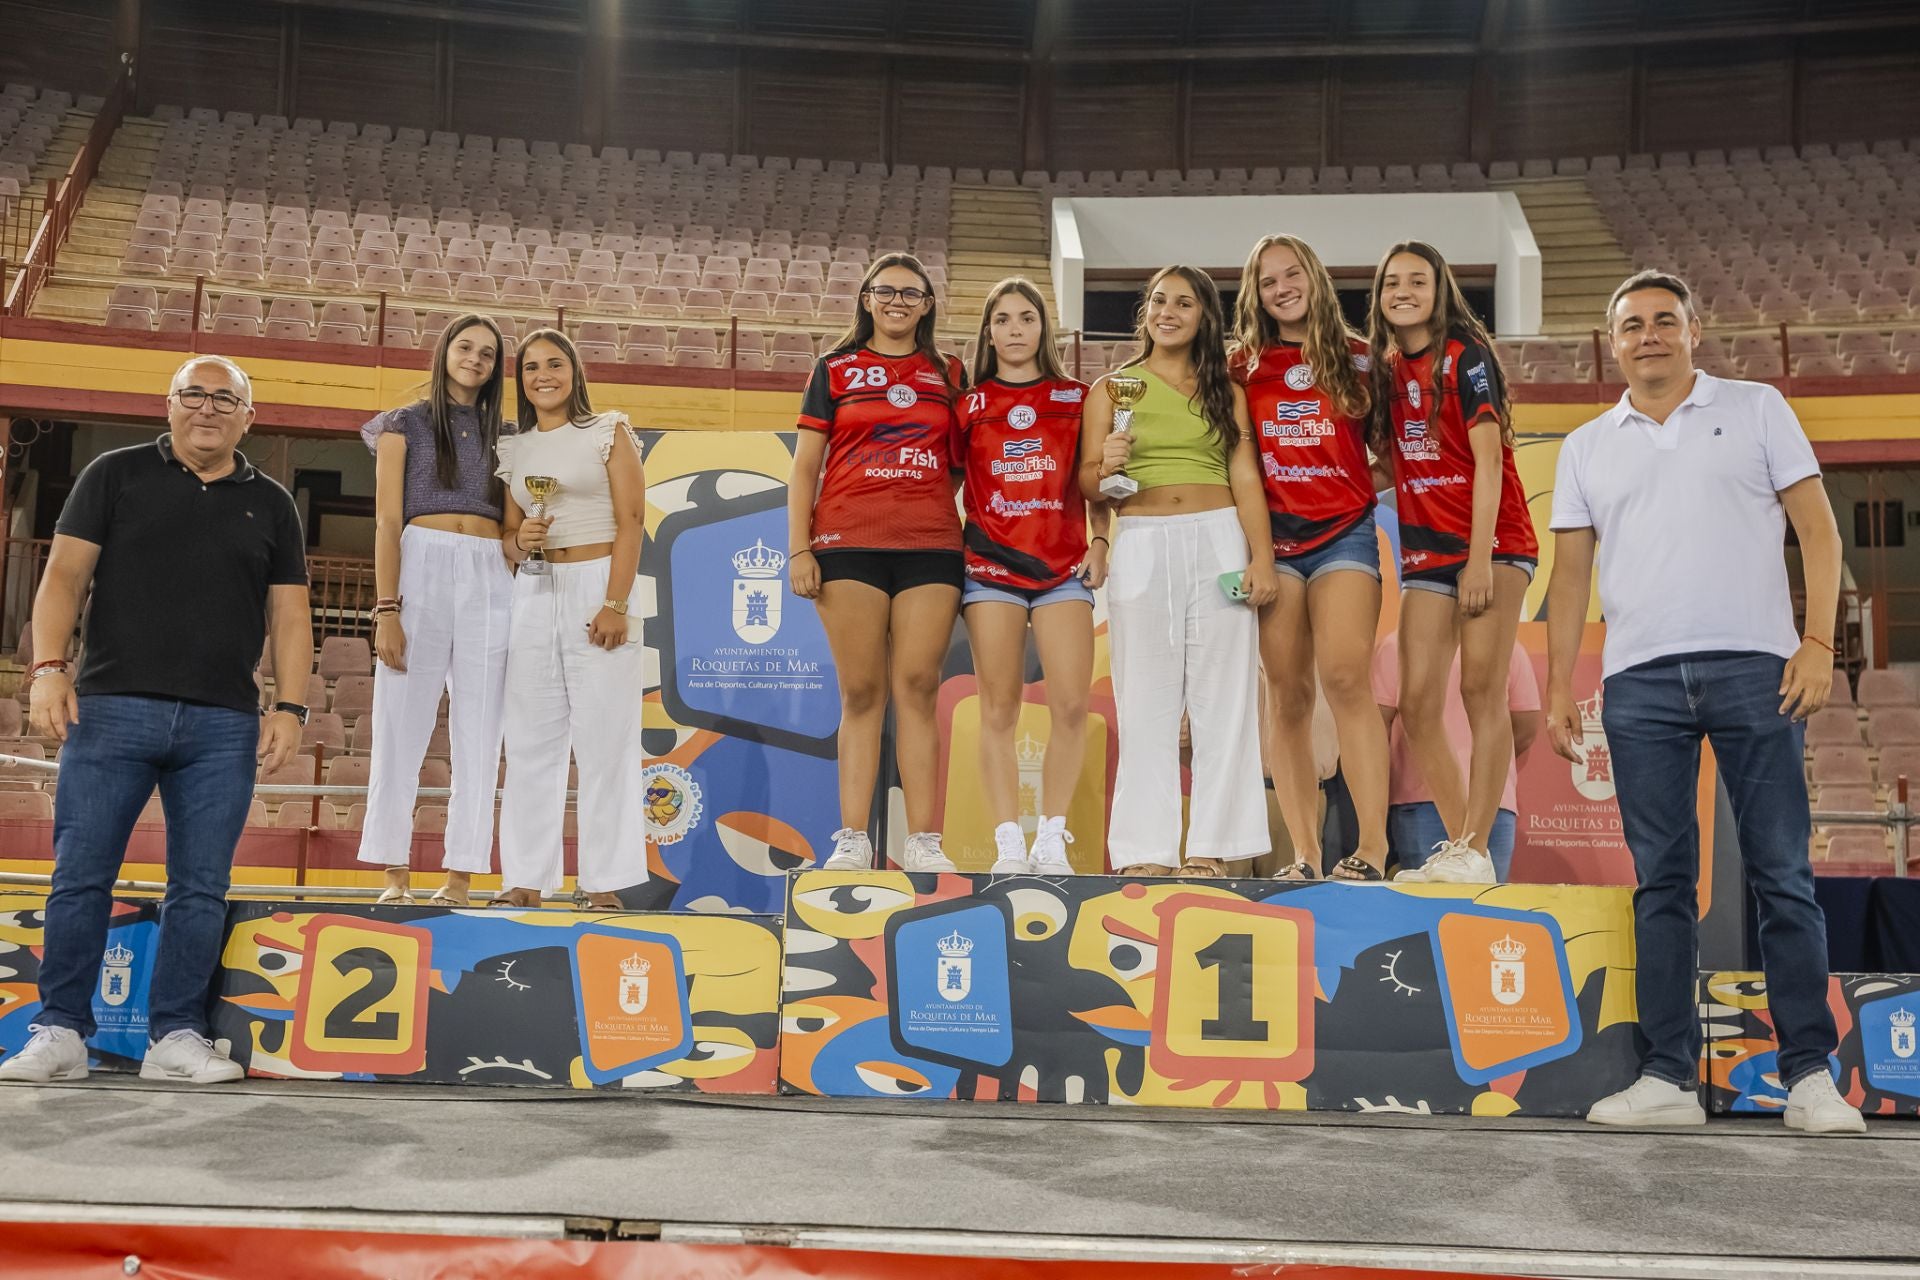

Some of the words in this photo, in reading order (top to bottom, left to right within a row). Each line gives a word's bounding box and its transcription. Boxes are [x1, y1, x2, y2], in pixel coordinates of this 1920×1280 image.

[845, 366, 887, 390] 28
[966, 392, 986, 414] 21
[1263, 419, 1334, 436] EuroFish
[1280, 437, 1320, 445] ROQUETAS
[847, 447, 938, 469] EuroFish
[992, 456, 1056, 475] EuroFish
[865, 468, 922, 479] ROQUETAS
[1006, 471, 1043, 481] ROQUETAS
[714, 648, 785, 656] AYUNTAMIENTO
[787, 648, 799, 656] DE
[692, 658, 760, 673] ROQUETAS
[765, 661, 781, 672] DE
[787, 659, 819, 673] MAR
[688, 680, 704, 688] Área
[715, 681, 746, 690] Deportes,
[779, 682, 805, 690] Tiempo
[805, 682, 823, 690] Libre
[642, 764, 690, 781] OQUETAS
[1553, 804, 1617, 813] AYUNTAMIEN
[1530, 815, 1603, 831] ROQUETAS
[1527, 838, 1543, 847] Área
[1545, 839, 1555, 847] de
[1556, 839, 1590, 848] Deportes,
[1592, 839, 1618, 848] Cultura
[324, 947, 399, 1040] 2
[1195, 934, 1268, 1041] 1
[910, 1010, 956, 1021] ROQUETAS
[975, 1012, 997, 1021] MAR
[1465, 1013, 1512, 1024] ROQUETAS
[1515, 1016, 1525, 1024] DE
[1530, 1015, 1552, 1025] MAR
[594, 1021, 635, 1031] ROQUETAS
[650, 1023, 669, 1032] MAR
[1873, 1063, 1907, 1072] ROQUETAS
